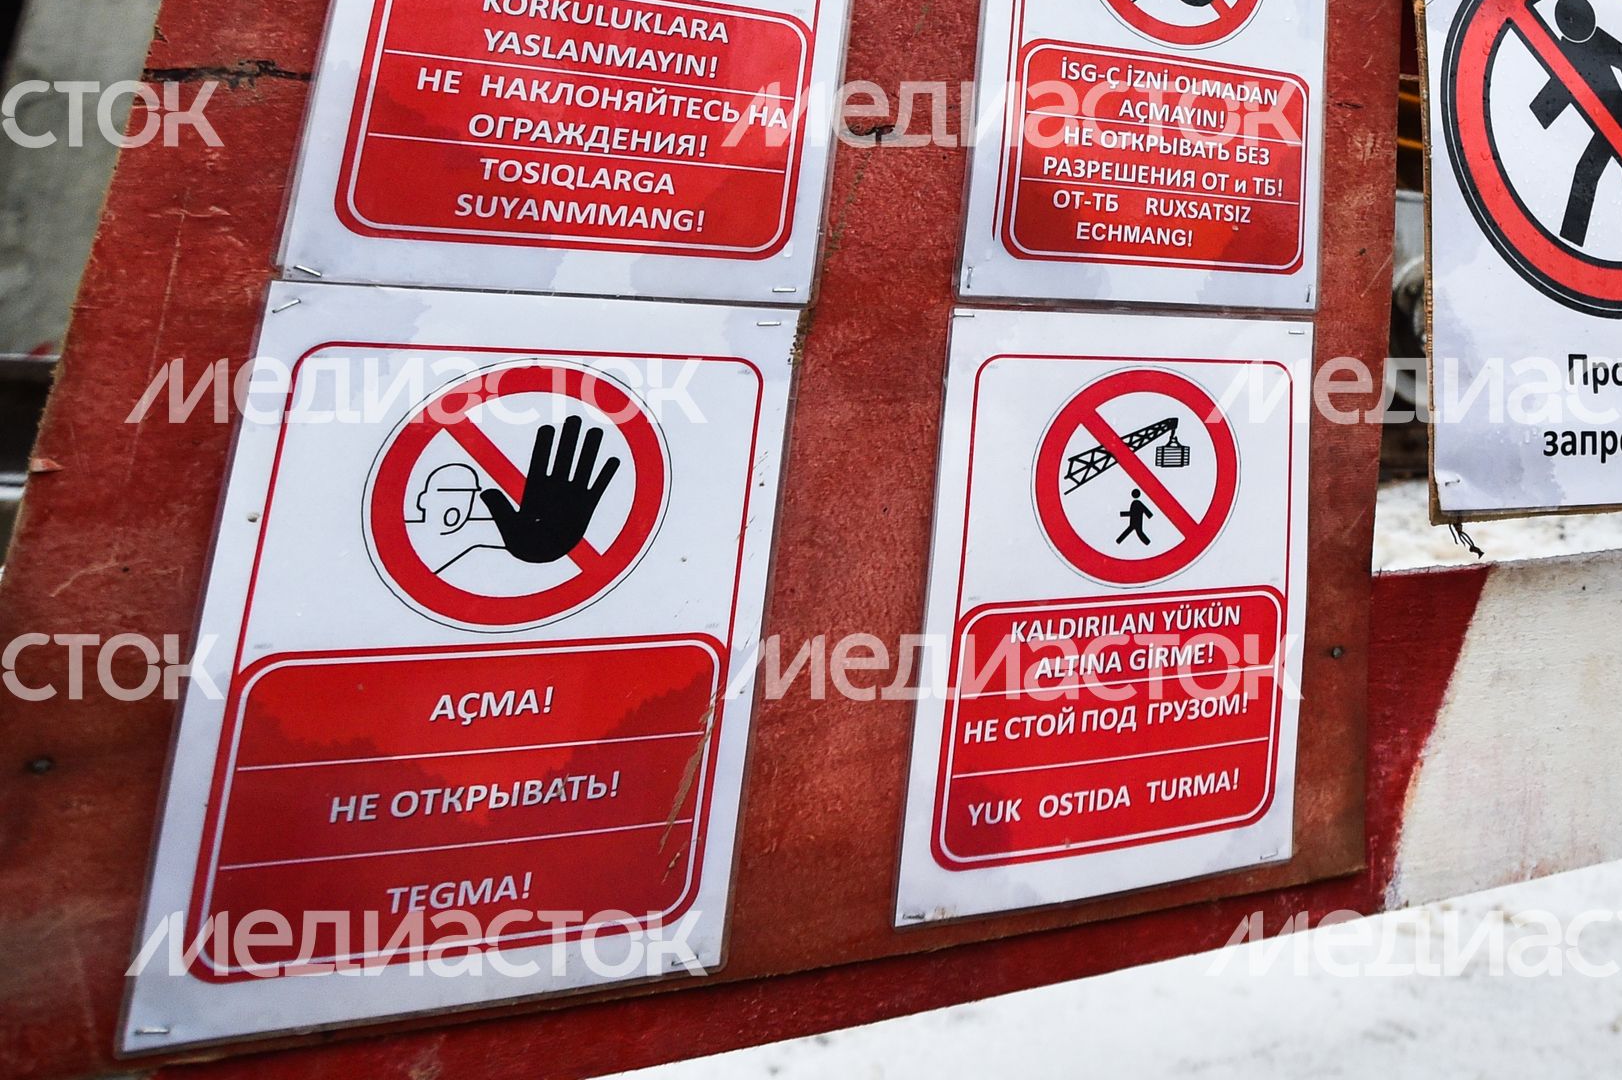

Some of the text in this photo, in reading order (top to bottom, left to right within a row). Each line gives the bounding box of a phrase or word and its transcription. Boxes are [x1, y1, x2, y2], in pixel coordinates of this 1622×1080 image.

[483, 29, 718, 79] YASLANMAYIN!
[416, 67, 789, 129] НЕ НАКЛОНЯЙТЕСЬ НА
[1126, 65, 1169, 91] İZNİ
[1174, 76, 1279, 105] OLMADAN
[1119, 100, 1225, 128] AÇMAYIN!
[468, 114, 708, 158] ОГРАЖДЕНИЯ!
[1064, 126, 1270, 165] НЕ ОТКРЫВАТЬ БЕЗ
[480, 158, 675, 195] TOSIQLARGA
[1043, 156, 1195, 188] РАЗРЕШЕНИЯ
[1201, 172, 1229, 191] ОТ
[1253, 177, 1283, 197] ТБ!
[454, 194, 705, 232] SUYANMMANG!
[1053, 190, 1119, 212] ОТ-ТБ
[1146, 198, 1251, 223] RUXSATSIZ
[1076, 222, 1193, 247] ECHMANG!
[1011, 603, 1241, 645] KALDIRILAN YÜKÜN
[1034, 640, 1215, 681] ALTINA GİRME!
[429, 686, 554, 725] AÇMA!
[963, 691, 1249, 745] НЕ СТОЙ ПОД ГРУЗОМ!
[329, 771, 621, 824] НЕ ОТКРЫВАТЬ!
[968, 767, 1240, 827] YUK OSTIDA TURMA!
[386, 872, 533, 915] TEGMA!
